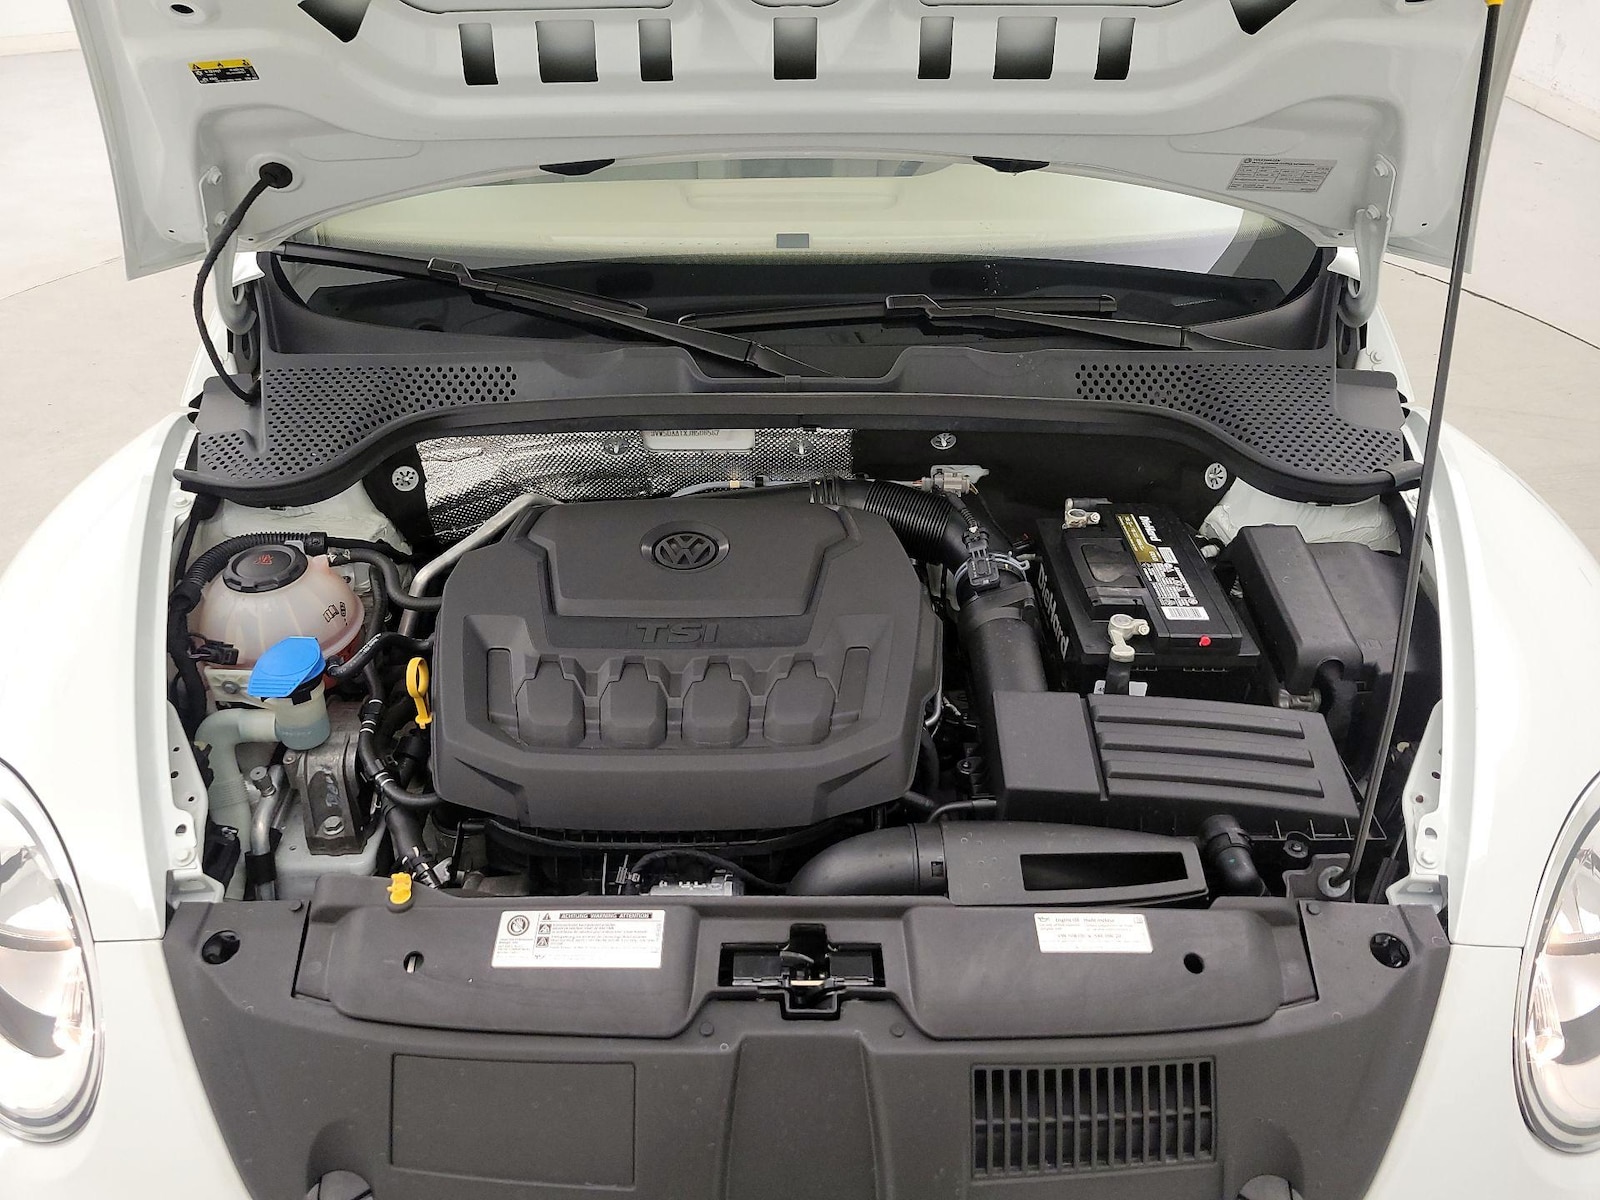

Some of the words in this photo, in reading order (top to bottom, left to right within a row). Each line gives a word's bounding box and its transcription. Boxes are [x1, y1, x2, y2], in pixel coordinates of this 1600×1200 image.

[1139, 515, 1162, 542] DieHard
[1037, 562, 1069, 660] DieHard
[636, 621, 720, 644] TSI
[561, 912, 589, 920] ACHTUNG
[590, 912, 617, 920] WARNING
[618, 912, 651, 920] ATTENTION
